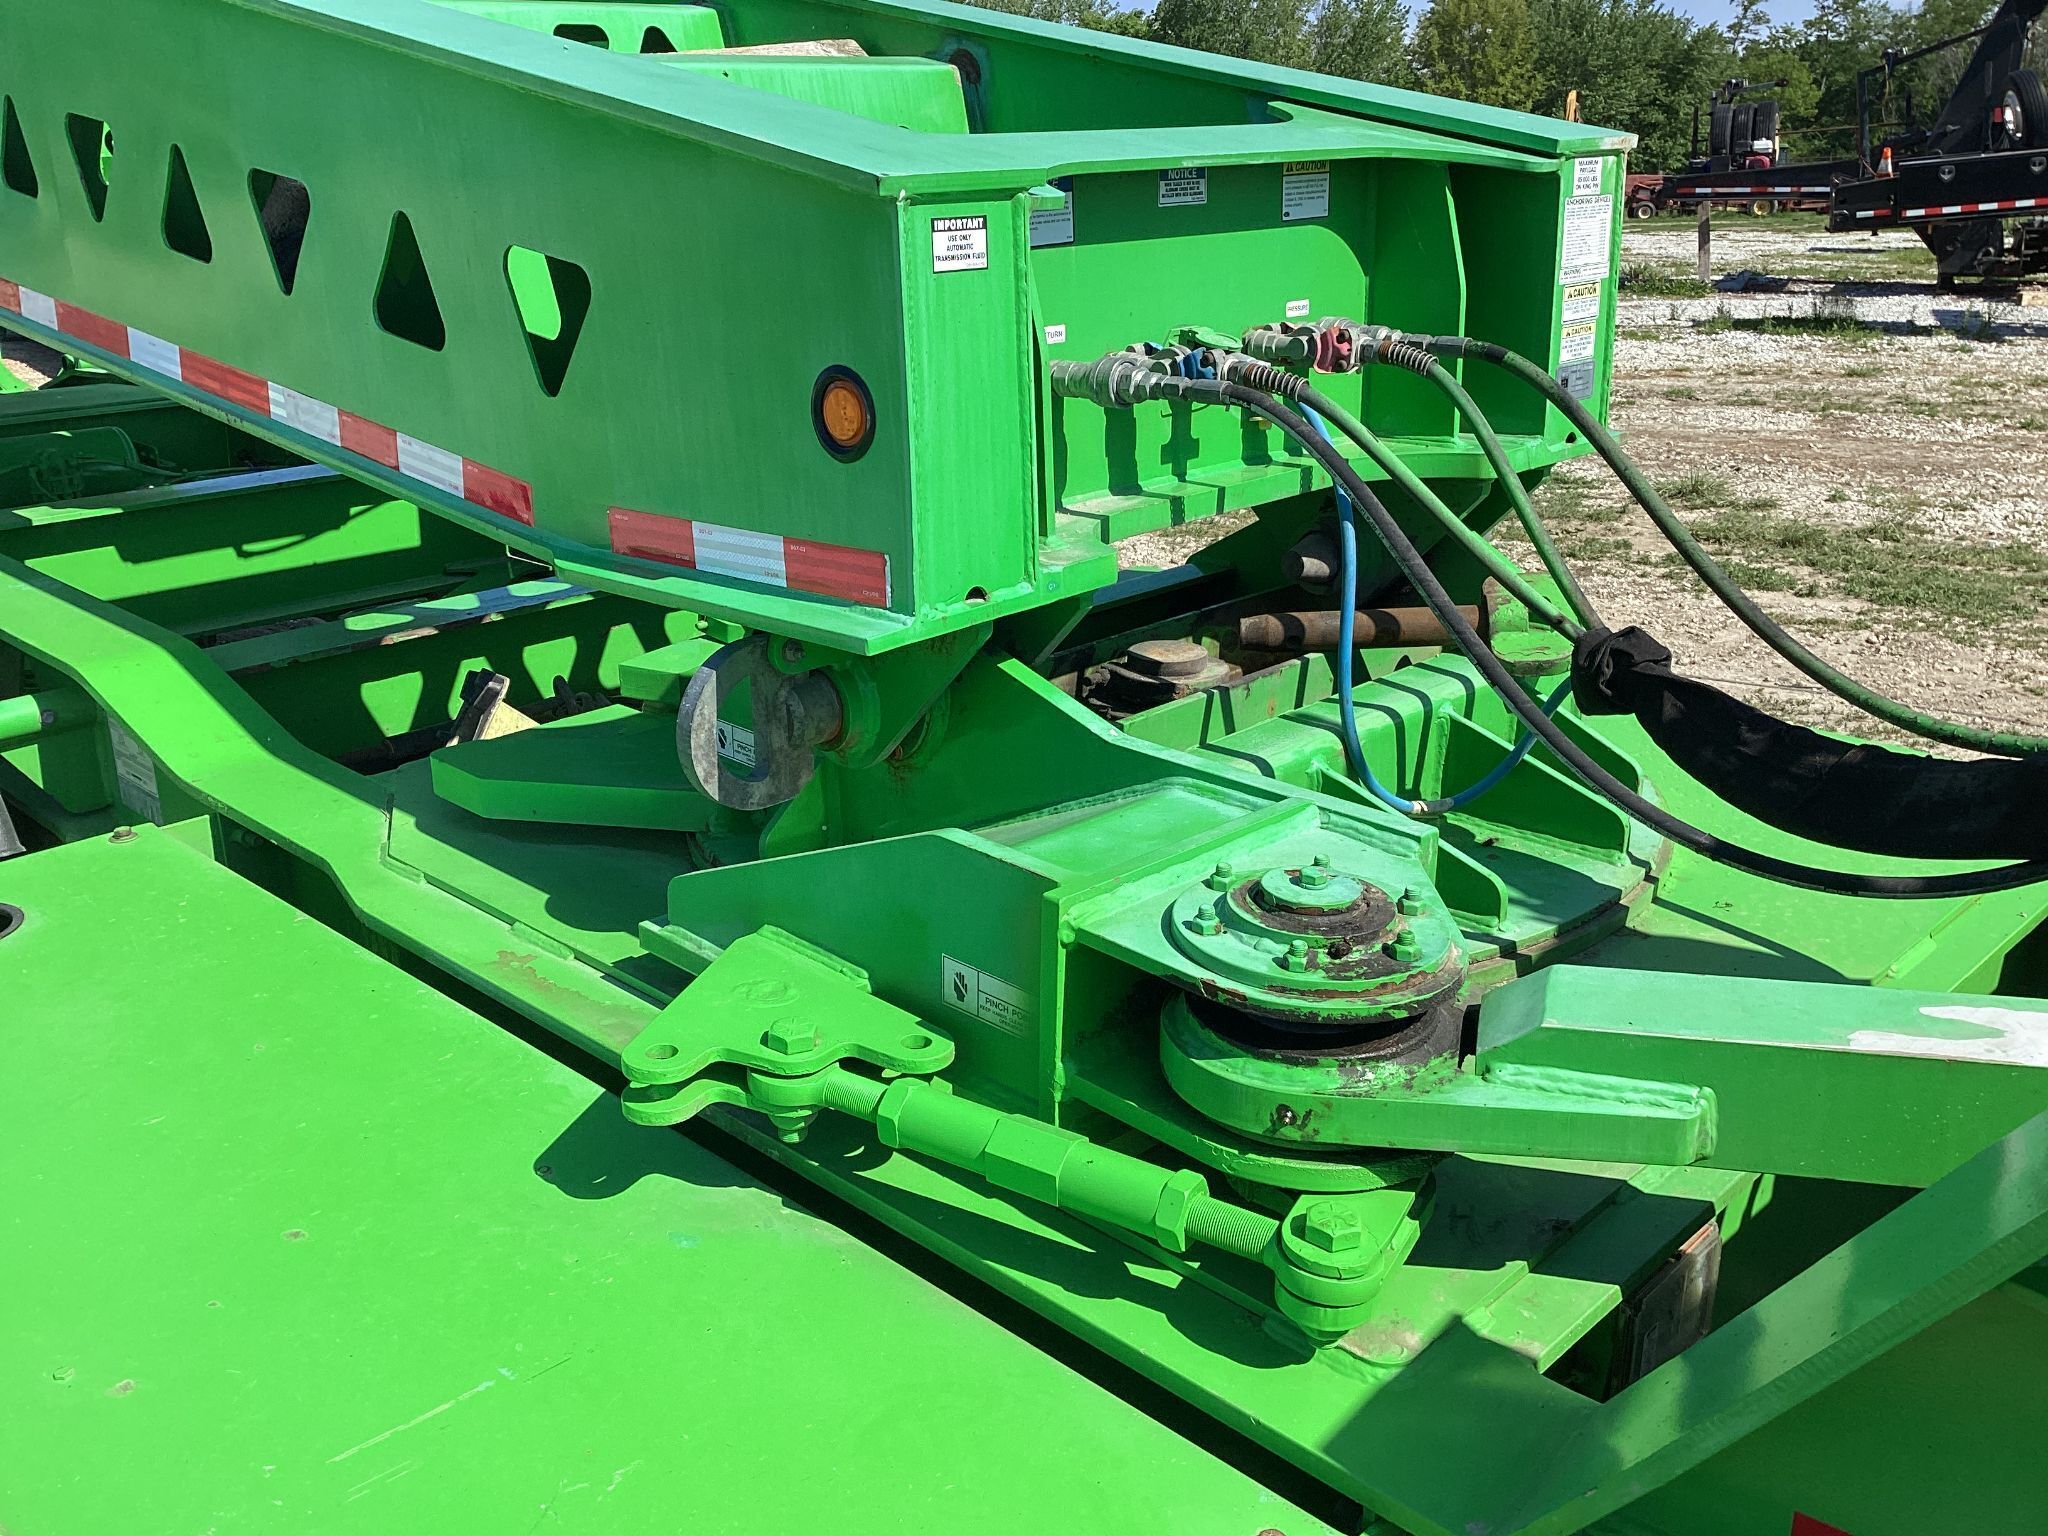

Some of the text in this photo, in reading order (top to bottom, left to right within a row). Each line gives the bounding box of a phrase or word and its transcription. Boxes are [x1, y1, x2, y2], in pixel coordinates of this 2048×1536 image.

[1295, 160, 1327, 172] CAUTION
[1168, 168, 1198, 180] NOTICE
[933, 217, 984, 231] IMPORTANT
[947, 233, 972, 242] USE ONLY
[946, 243, 974, 252] AUTOMATIC
[935, 253, 971, 262] TRANSMISSION
[1573, 286, 1597, 298] CAUTION
[1046, 330, 1063, 339] TURN
[1571, 325, 1592, 336] CAUTION
[985, 996, 1009, 1015] PINCH
